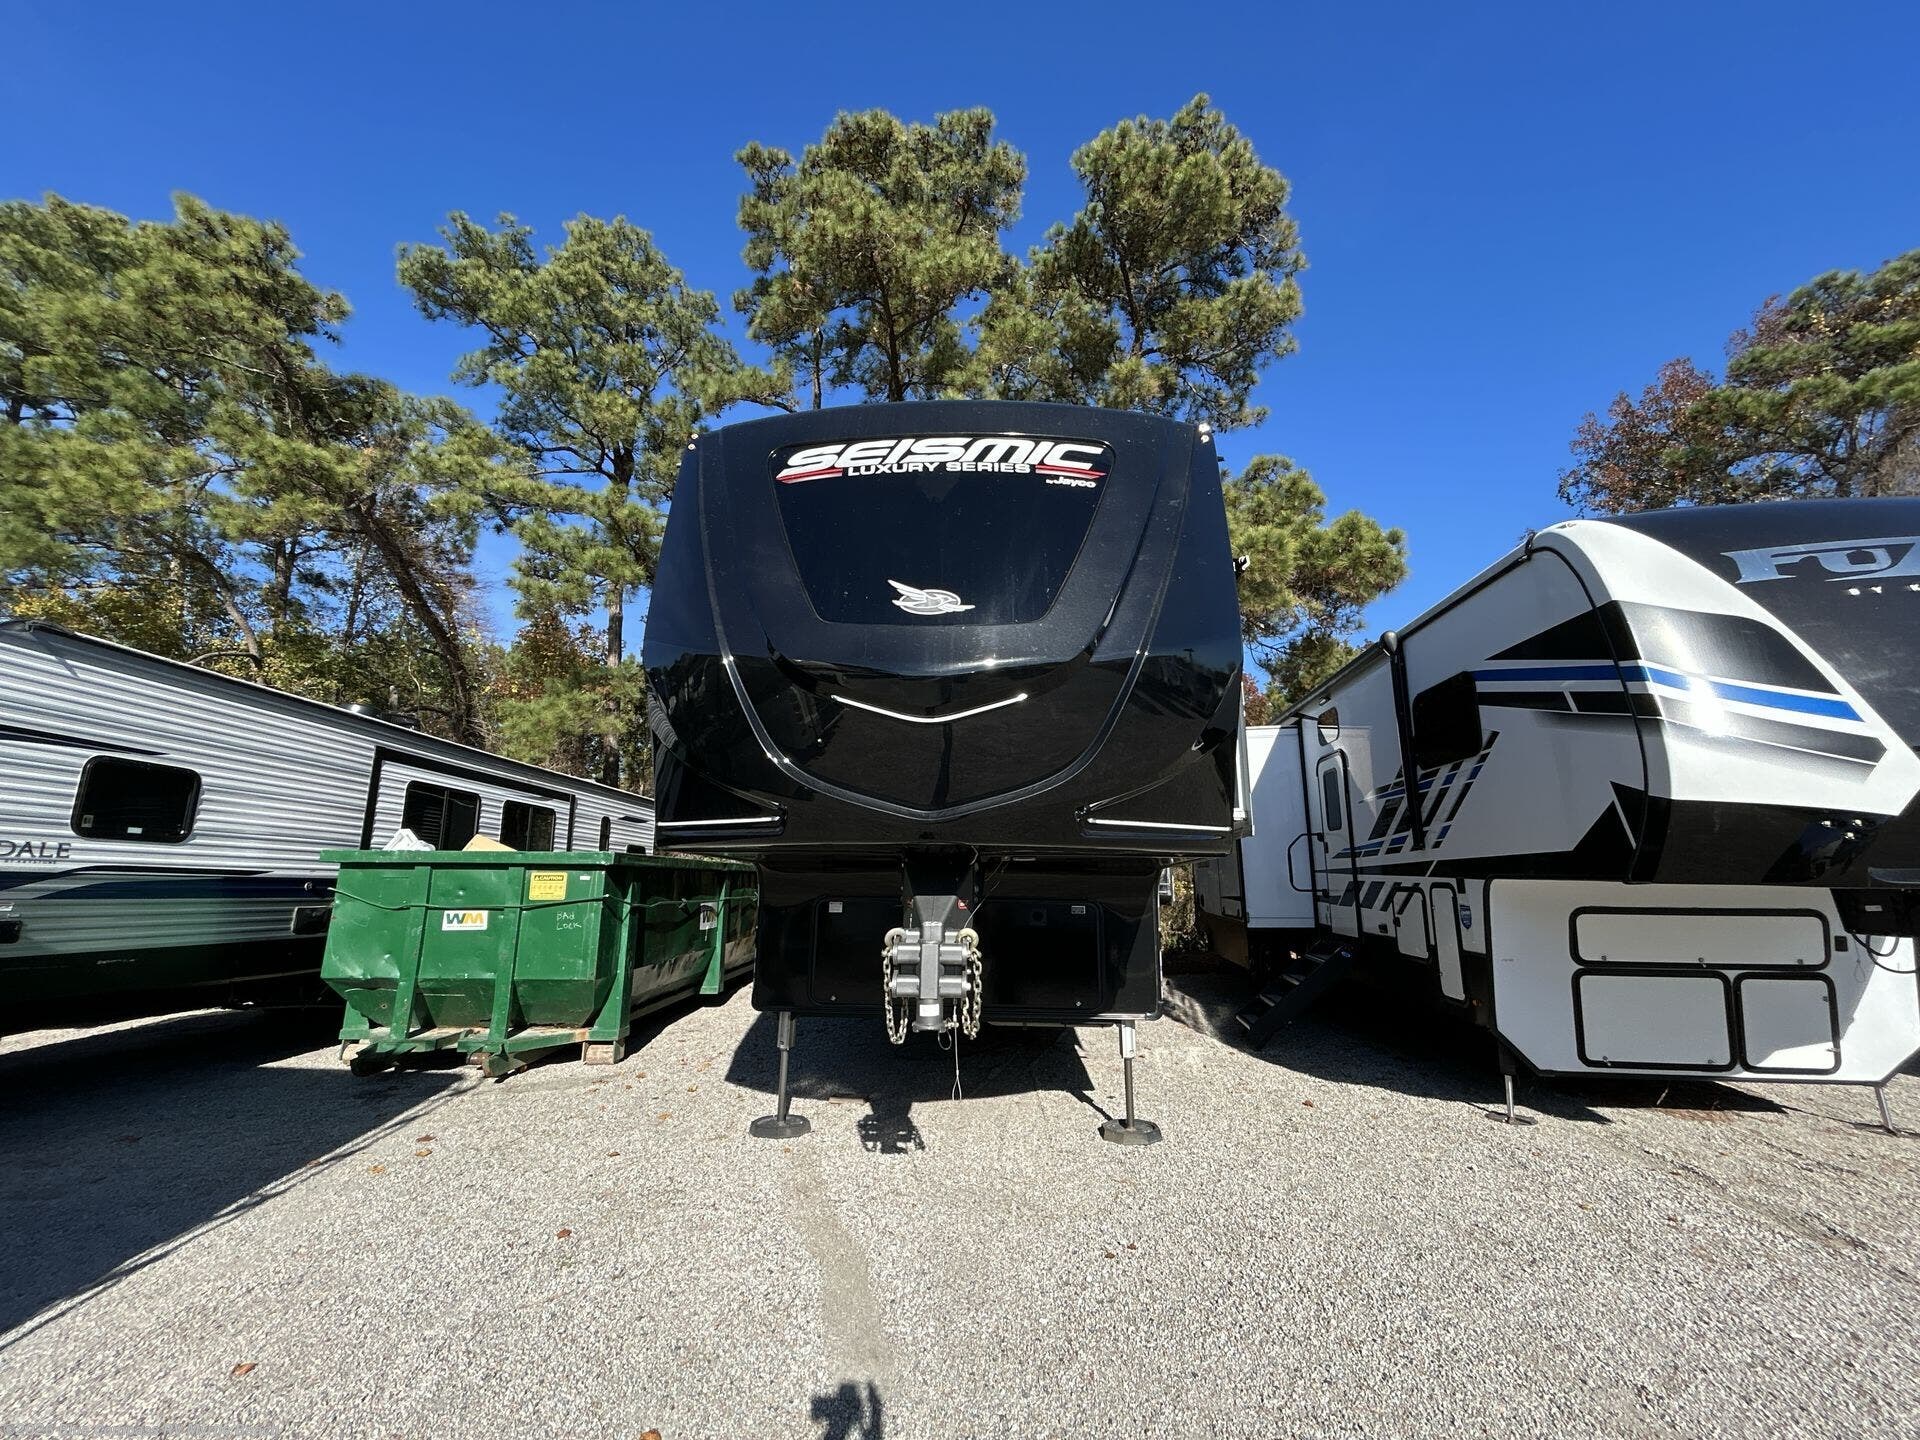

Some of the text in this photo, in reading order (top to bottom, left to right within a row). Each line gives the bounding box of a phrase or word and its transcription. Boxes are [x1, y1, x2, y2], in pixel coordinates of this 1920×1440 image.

[776, 437, 1104, 479] SEISMIC
[848, 461, 1031, 477] LUXURY SERIES
[1053, 476, 1097, 488] Jayco
[446, 913, 484, 924] WM
